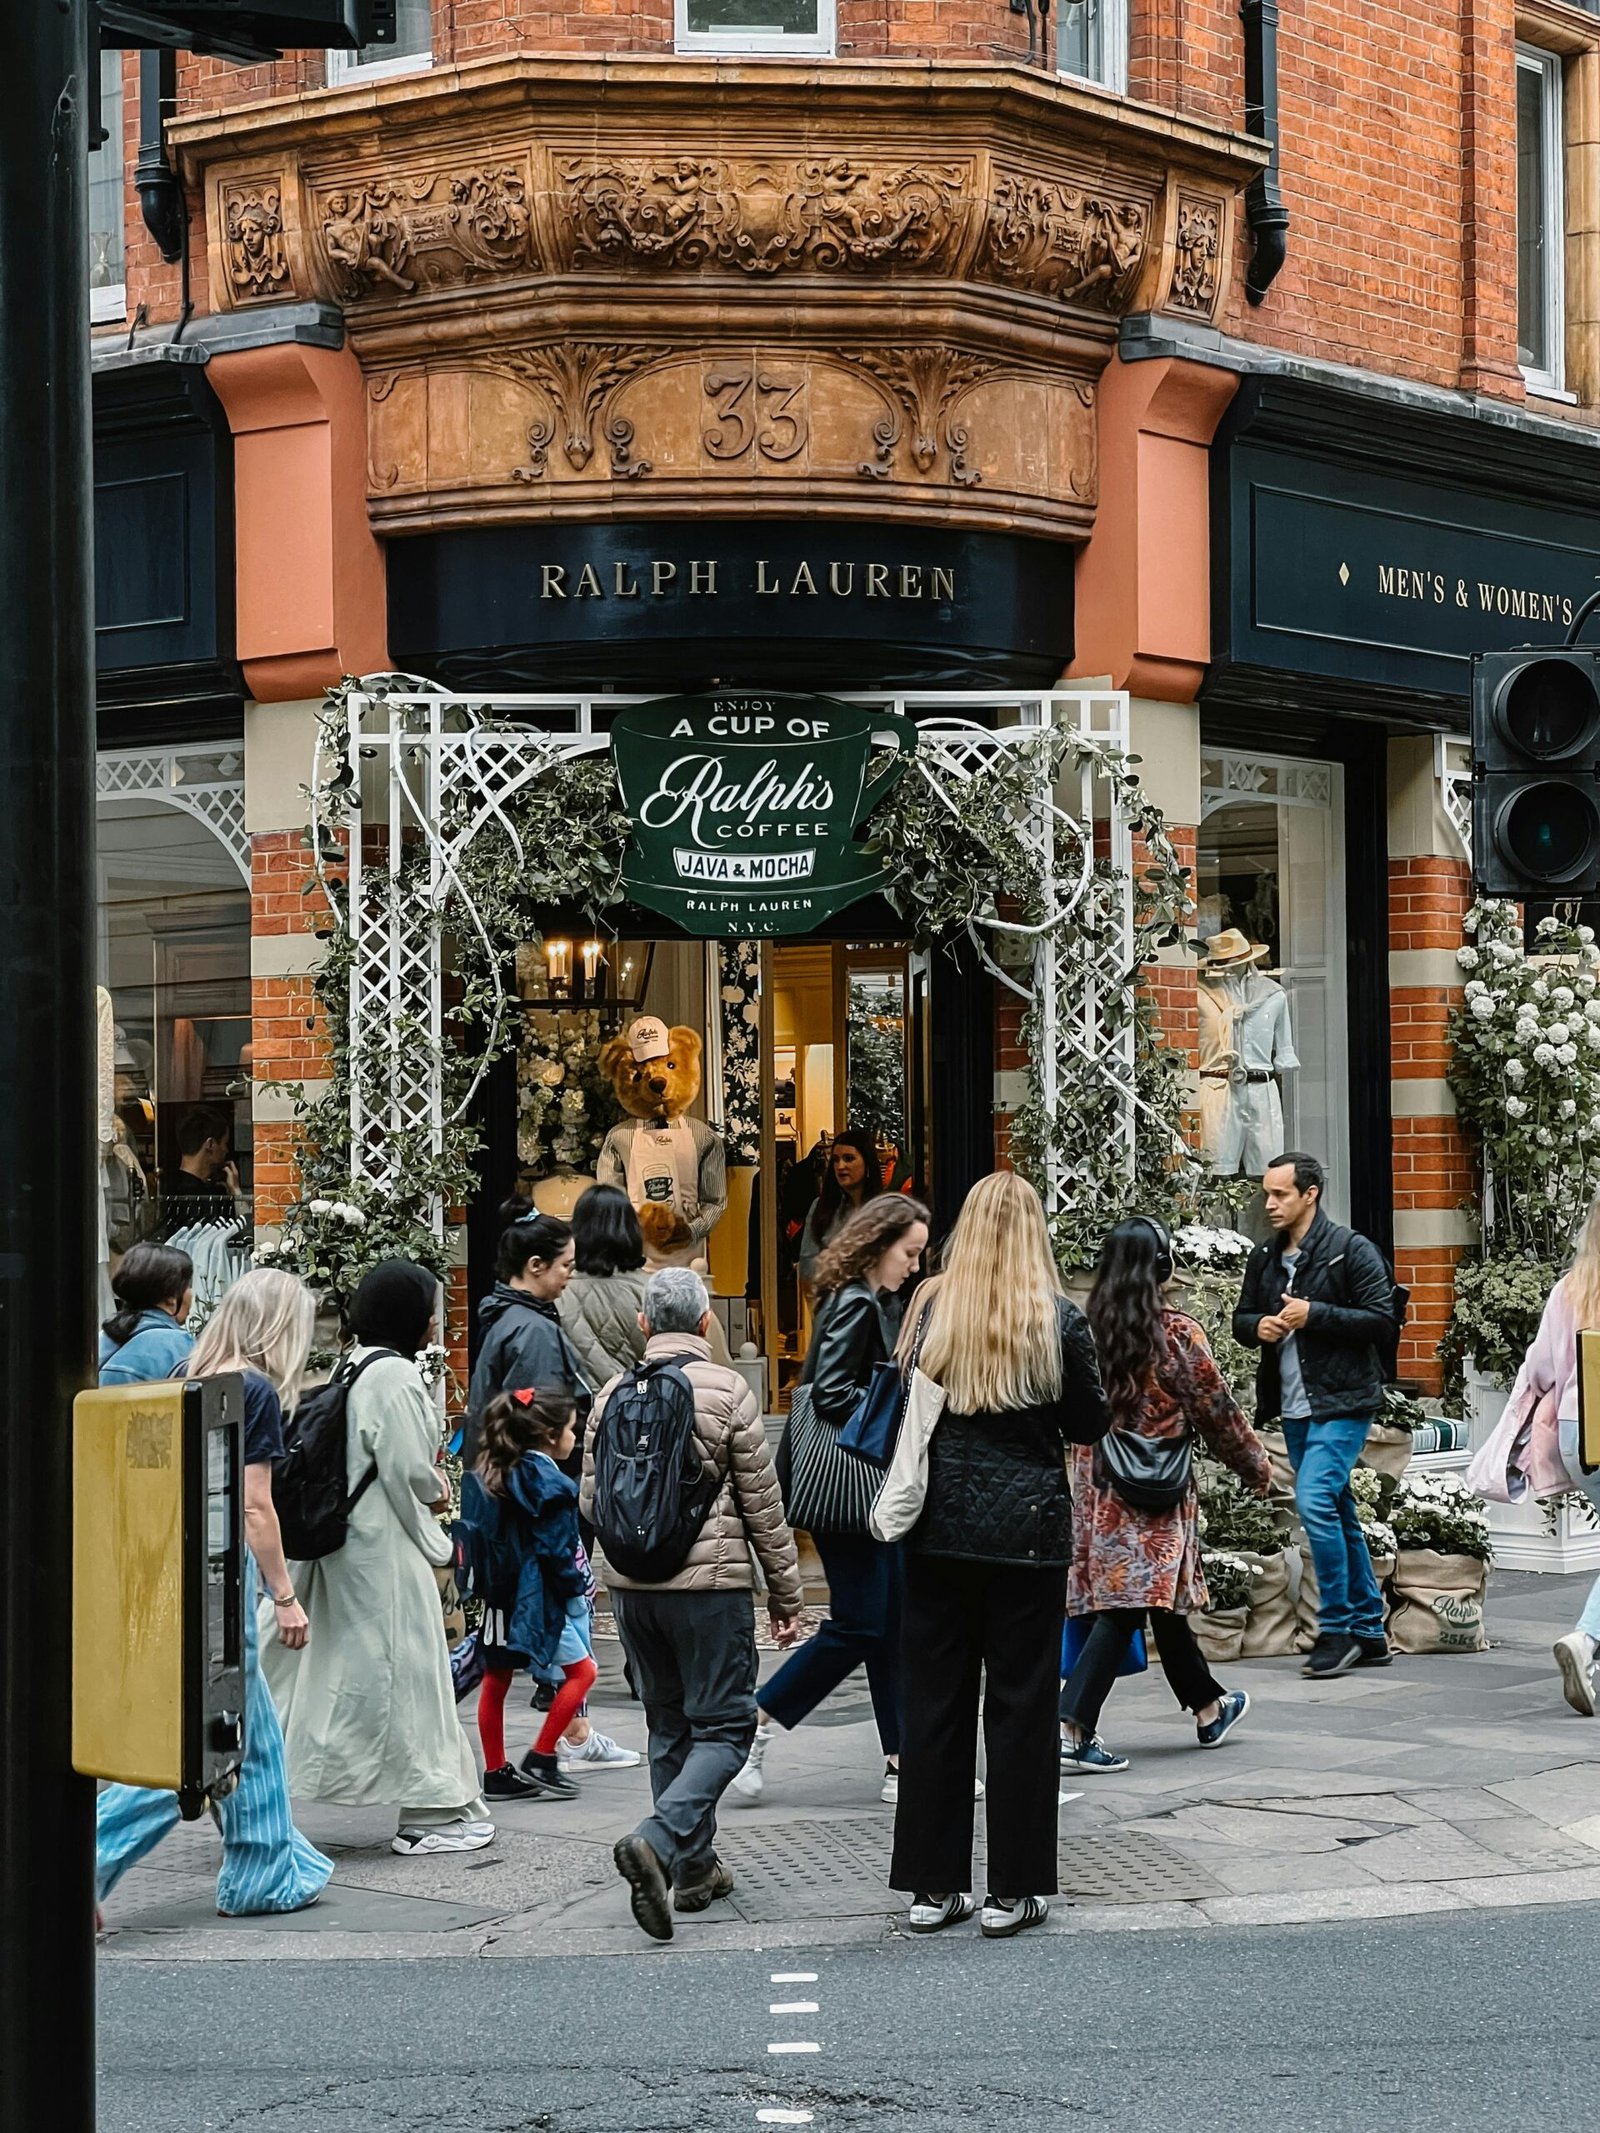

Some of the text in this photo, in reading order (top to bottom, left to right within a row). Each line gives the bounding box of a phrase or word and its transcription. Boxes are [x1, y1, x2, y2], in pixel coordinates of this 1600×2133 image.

[704, 372, 808, 460] 33
[540, 560, 956, 601] RALPH LAUREN
[1378, 565, 1573, 626] MEN'S & WOMEN'S
[712, 701, 775, 712] ENJOY
[669, 716, 830, 738] A CUP OF
[639, 754, 834, 849] Ralph's
[716, 823, 829, 838] COFFEE
[681, 853, 810, 879] JAVA & MOCHA
[686, 899, 812, 912] RALPH LAUREN
[728, 921, 780, 933] N.Y.C.
